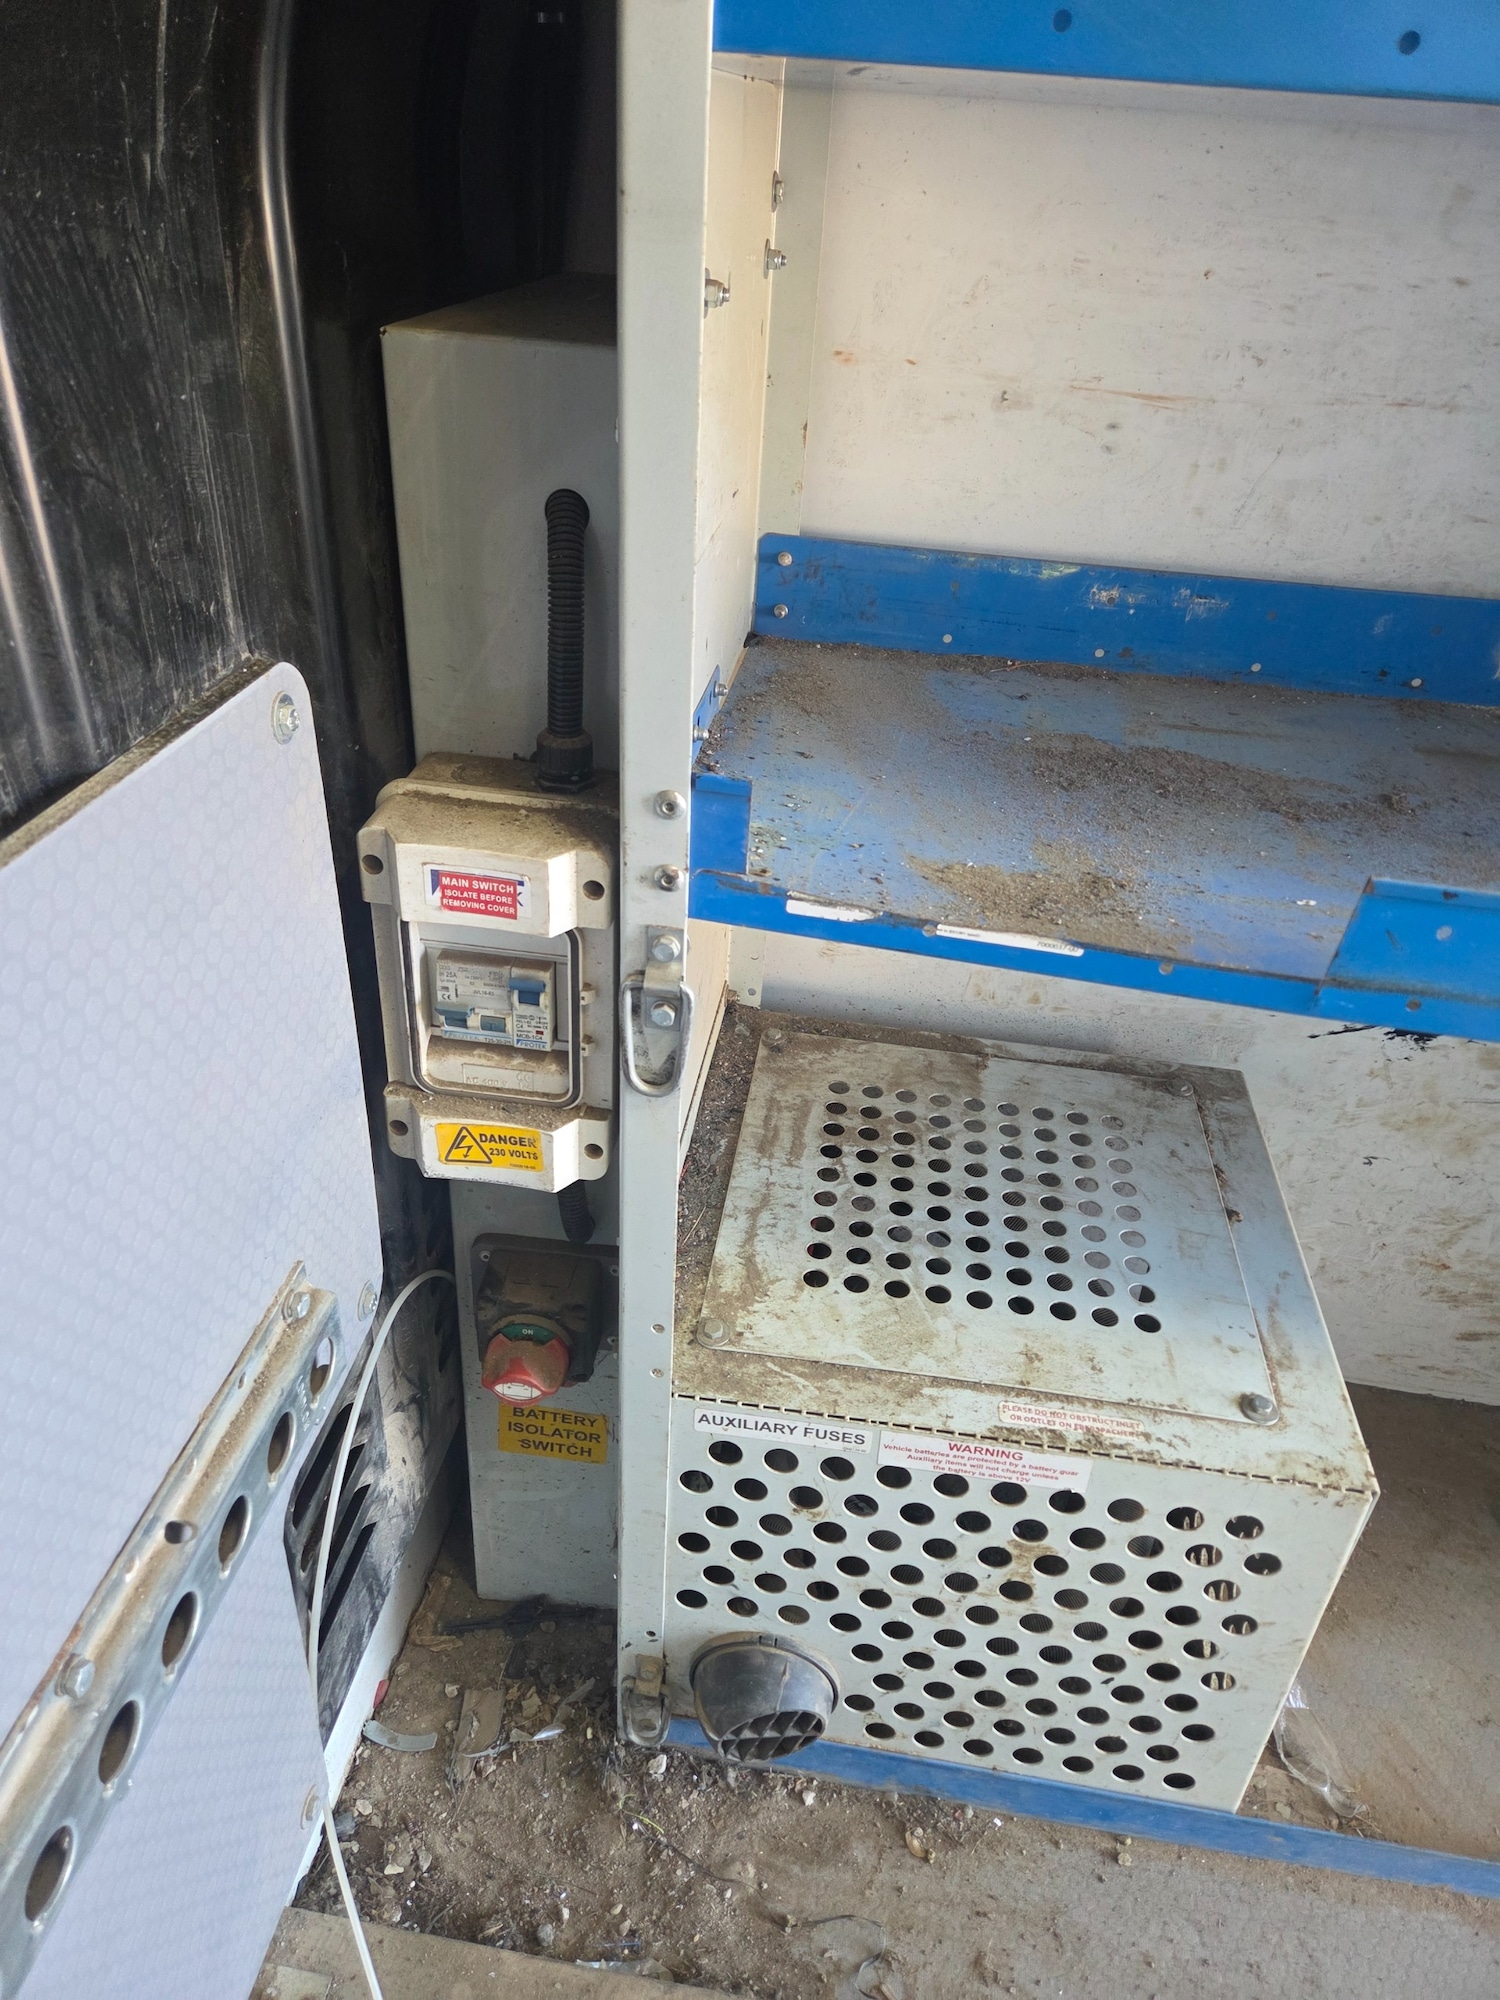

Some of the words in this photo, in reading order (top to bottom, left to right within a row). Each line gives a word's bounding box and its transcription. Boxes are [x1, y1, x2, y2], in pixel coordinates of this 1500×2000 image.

[441, 876, 469, 888] MAIN
[472, 880, 514, 894] SWITCH
[444, 889, 478, 900] ISOLATE
[480, 893, 513, 905] BEFORE
[442, 898, 486, 910] REMOVING
[487, 904, 515, 915] COVER
[519, 1041, 547, 1050] PROTEK
[479, 1133, 538, 1149] DANGER
[489, 1147, 506, 1157] 230
[508, 1149, 539, 1161] VOLTS
[521, 1328, 534, 1336] ON
[512, 1406, 599, 1428] BATTERY
[1001, 1404, 1034, 1415] PLEASE
[1034, 1408, 1048, 1417] DO
[1048, 1410, 1067, 1420] NOT
[1069, 1413, 1114, 1426] OBSTRUCT
[1115, 1420, 1141, 1430] INLET
[1009, 1414, 1023, 1422] OR
[1058, 1420, 1073, 1429] ON
[507, 1421, 602, 1444] ISOLATOR
[698, 1413, 799, 1436] AUXILIARY
[803, 1426, 866, 1446] FUSES
[519, 1438, 593, 1458] SWITCH
[948, 1442, 1024, 1462] WARNING
[883, 1443, 913, 1453] Vehicle
[914, 1448, 951, 1459] batteries
[967, 1455, 1007, 1467] protected
[1008, 1461, 1020, 1469] by
[1028, 1464, 1059, 1475] battery
[906, 1454, 944, 1465] Auxiliary
[945, 1460, 968, 1468] items
[985, 1465, 1000, 1473] not
[1001, 1467, 1031, 1477] charge
[1031, 1471, 1060, 1481] unless
[947, 1467, 977, 1476] battery
[977, 1470, 987, 1478] is
[987, 1473, 1013, 1481] above
[1015, 1475, 1032, 1483] 12V
